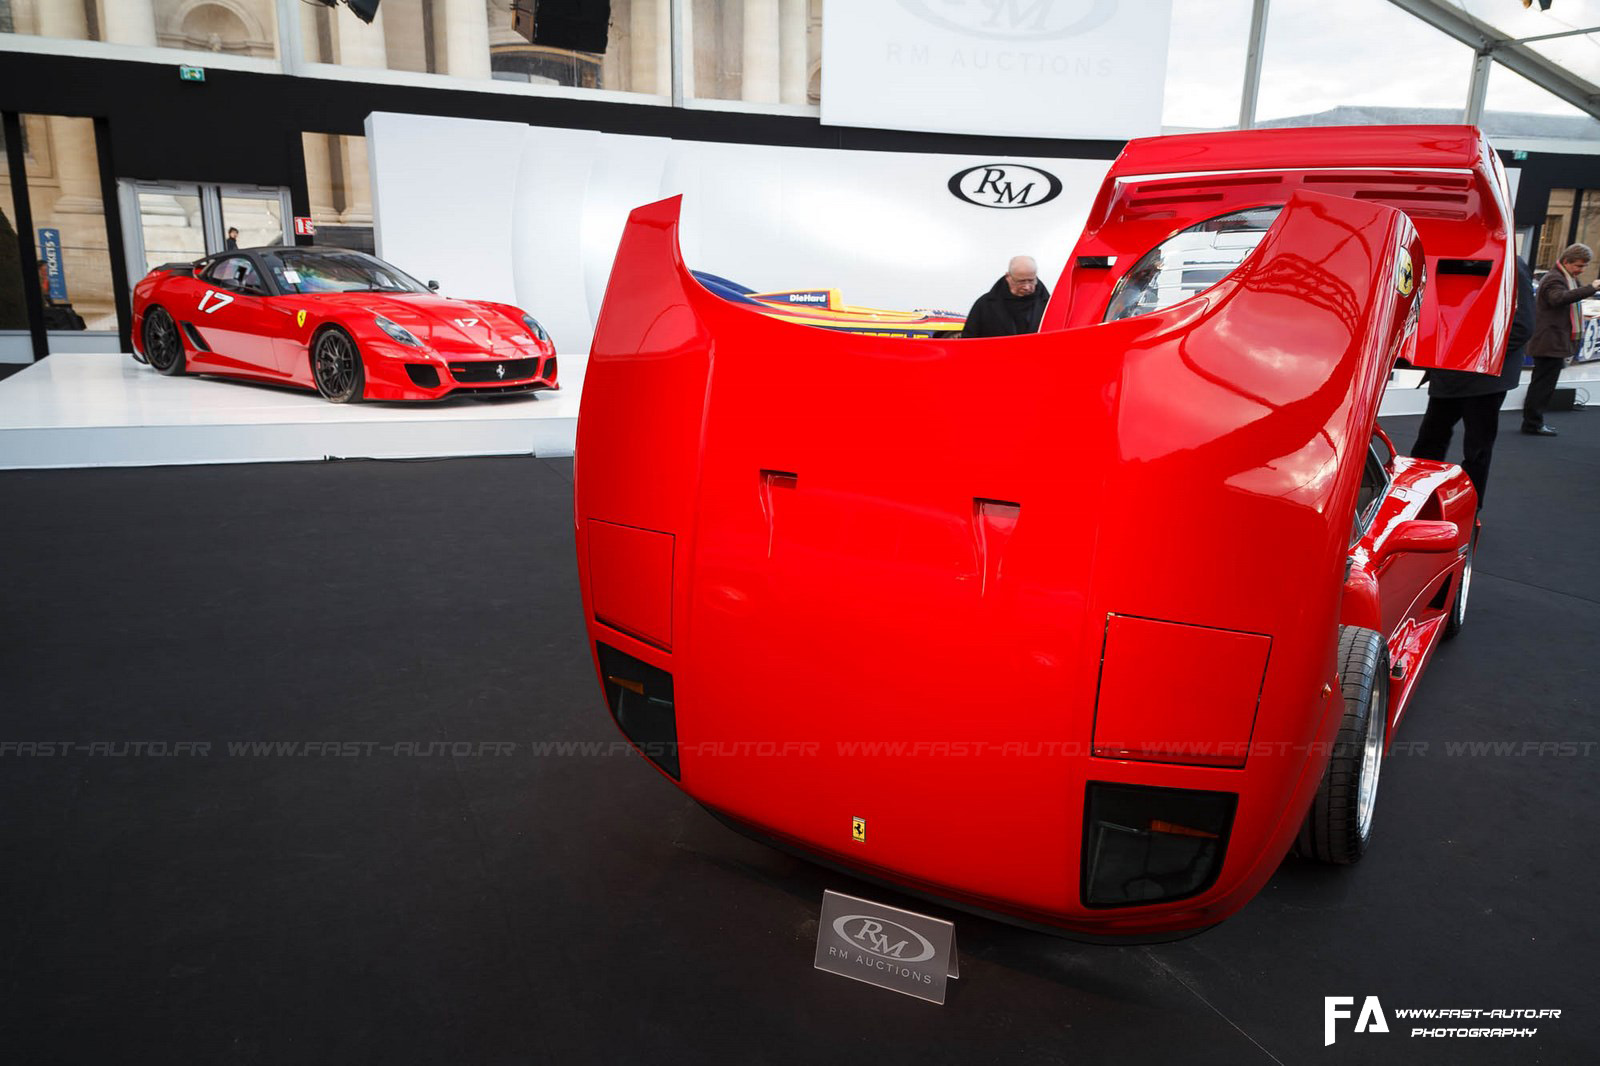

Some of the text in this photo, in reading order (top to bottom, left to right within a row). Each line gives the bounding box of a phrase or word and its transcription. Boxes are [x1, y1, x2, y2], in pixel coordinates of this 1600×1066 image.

[886, 43, 1113, 77] RM AUCTIONS
[973, 167, 1036, 204] RM
[45, 241, 59, 277] TICKETS
[198, 290, 234, 319] 17
[789, 294, 827, 303] DieHard
[454, 318, 480, 328] 17
[854, 919, 909, 958] RM
[828, 946, 932, 985] RM AUCTIONS
